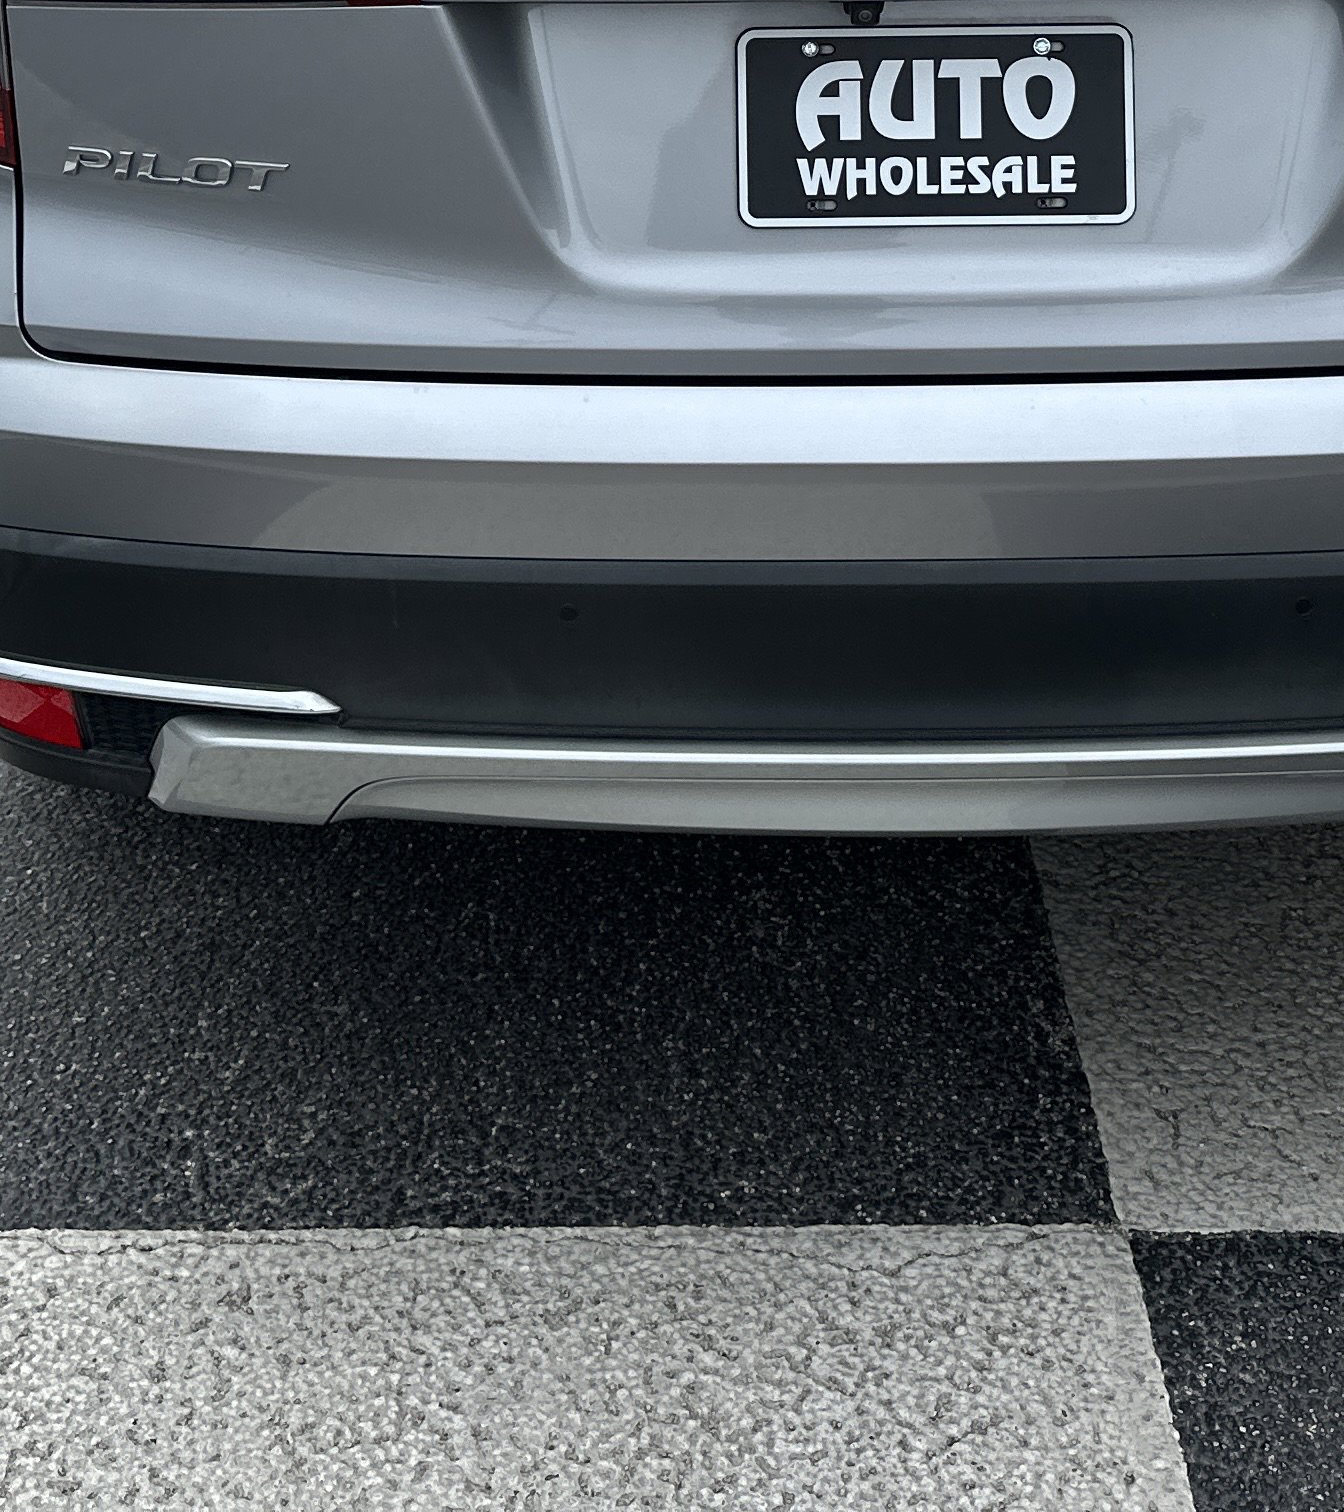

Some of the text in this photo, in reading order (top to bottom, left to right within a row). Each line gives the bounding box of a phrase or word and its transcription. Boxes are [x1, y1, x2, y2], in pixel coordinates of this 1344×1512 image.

[795, 56, 1076, 152] AUTO
[62, 145, 291, 192] PILOT
[796, 155, 1077, 201] WHOLESALE
